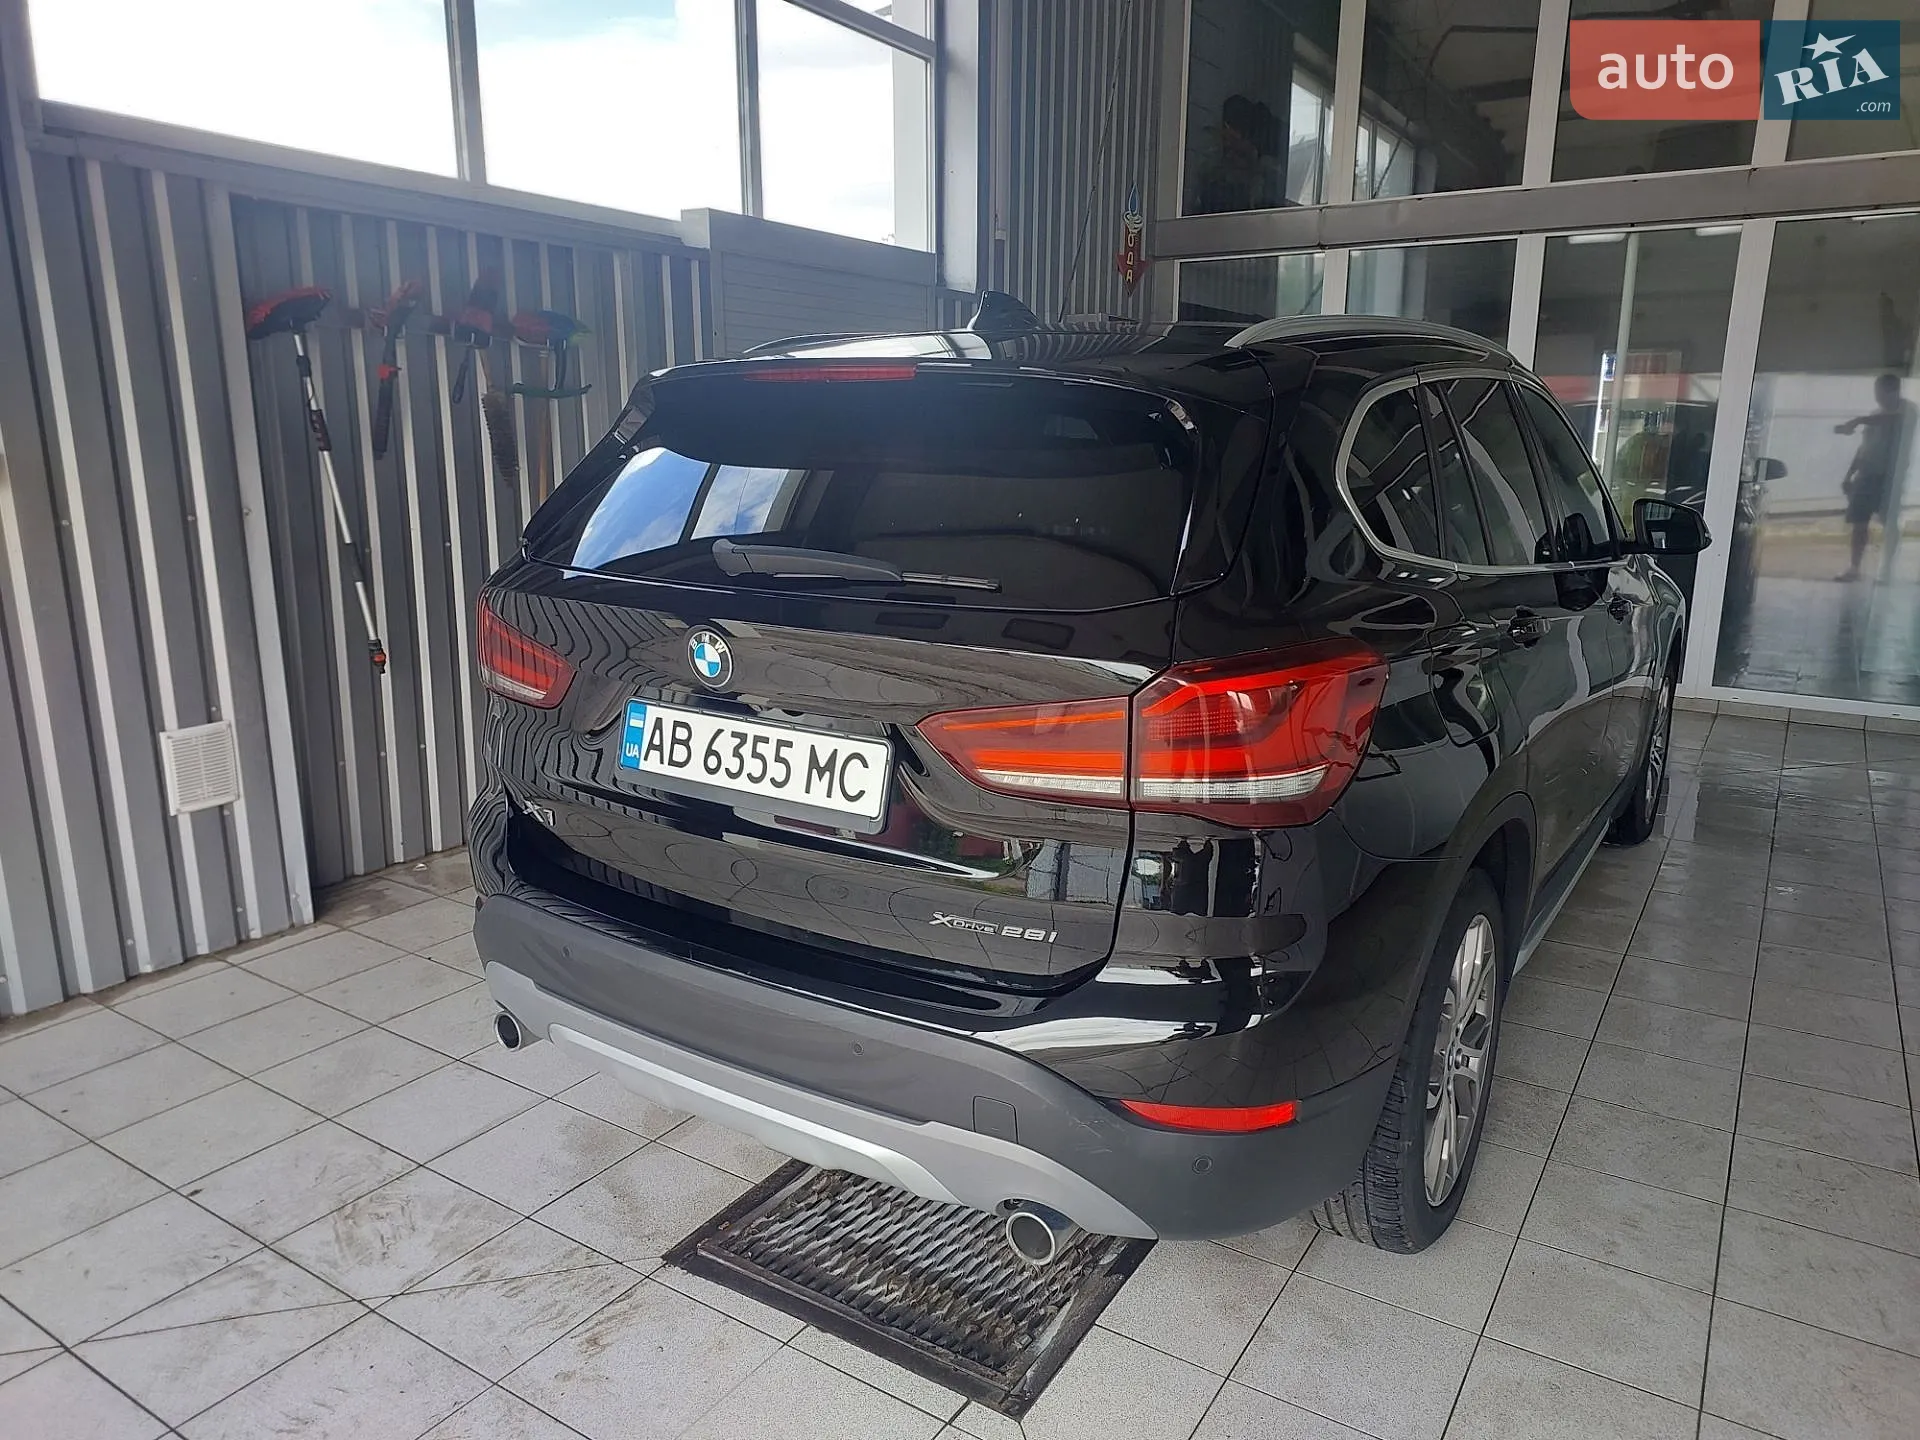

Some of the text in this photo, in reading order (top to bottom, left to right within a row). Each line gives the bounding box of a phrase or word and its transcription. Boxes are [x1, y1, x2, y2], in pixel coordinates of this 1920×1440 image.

[690, 633, 726, 654] BMW
[625, 742, 640, 759] UA
[643, 716, 870, 802] AB 6355 MC
